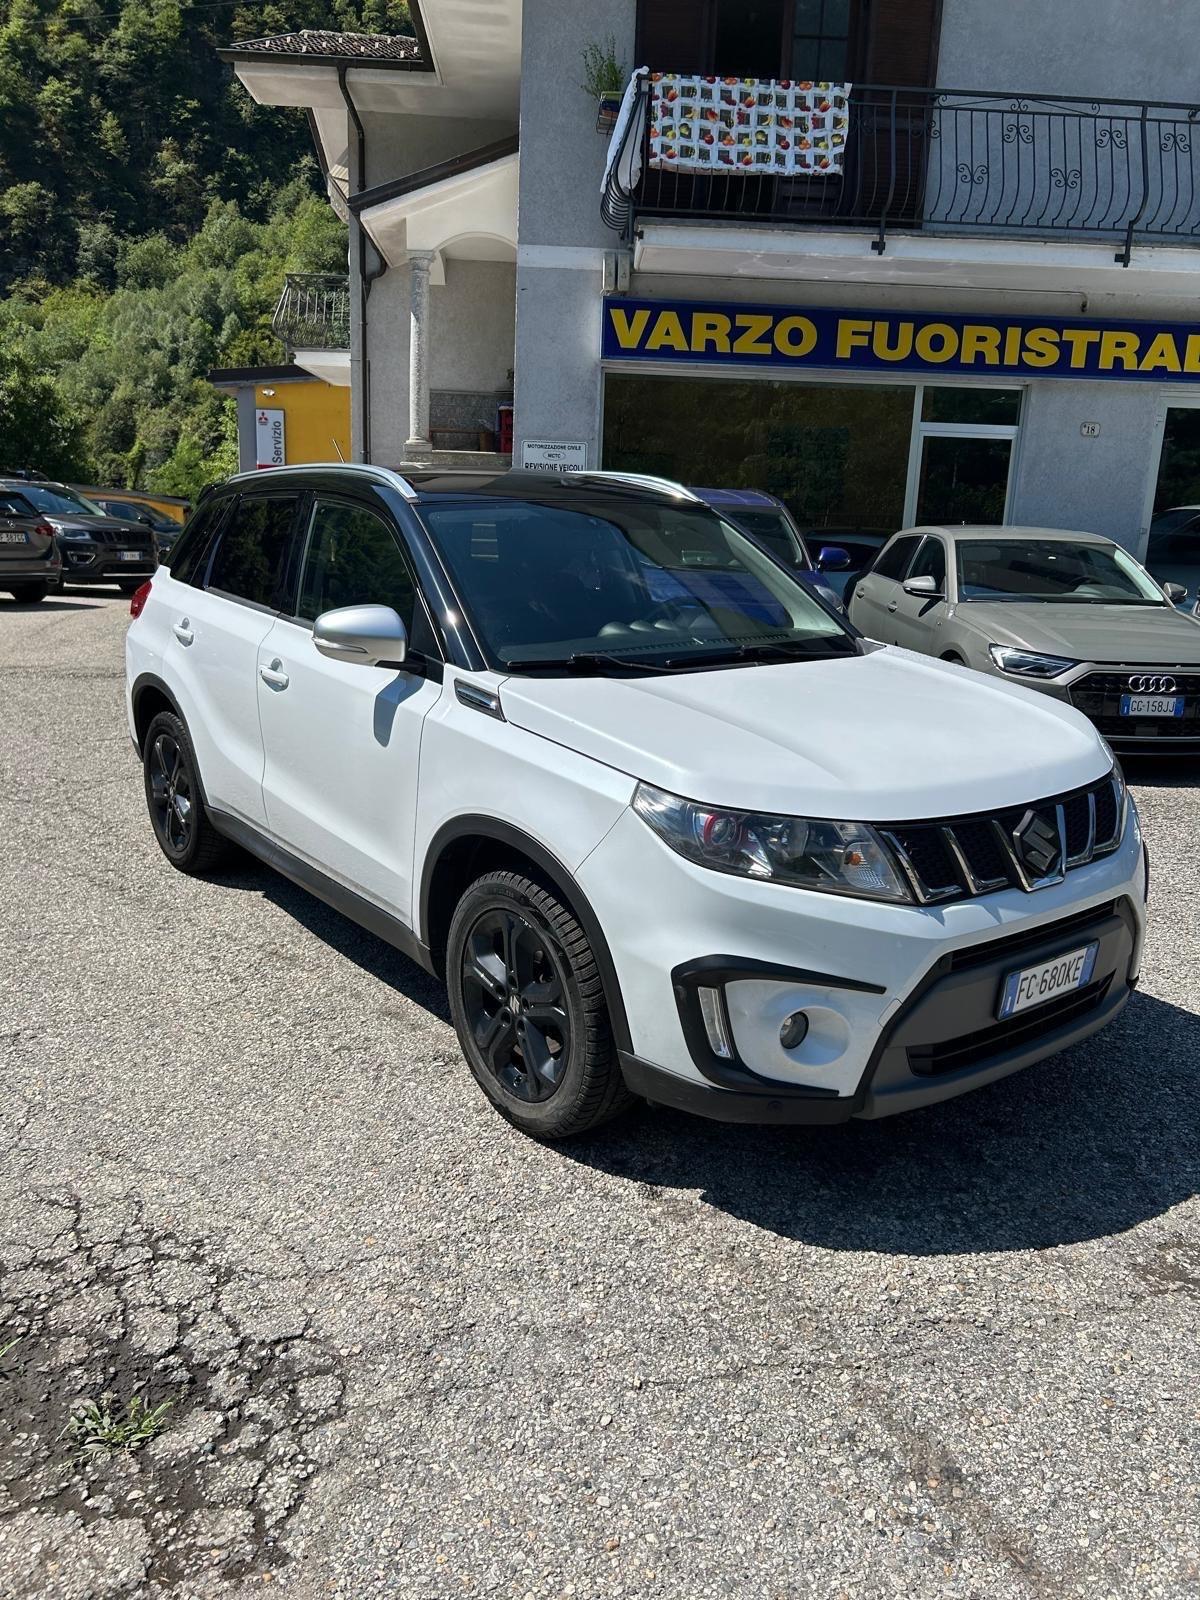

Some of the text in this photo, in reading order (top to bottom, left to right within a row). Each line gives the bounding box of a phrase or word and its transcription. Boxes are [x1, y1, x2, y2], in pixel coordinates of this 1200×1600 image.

[610, 308, 818, 358] VARZO
[272, 420, 283, 464] Servizio
[524, 462, 584, 472] REVISIONE VEICOLI
